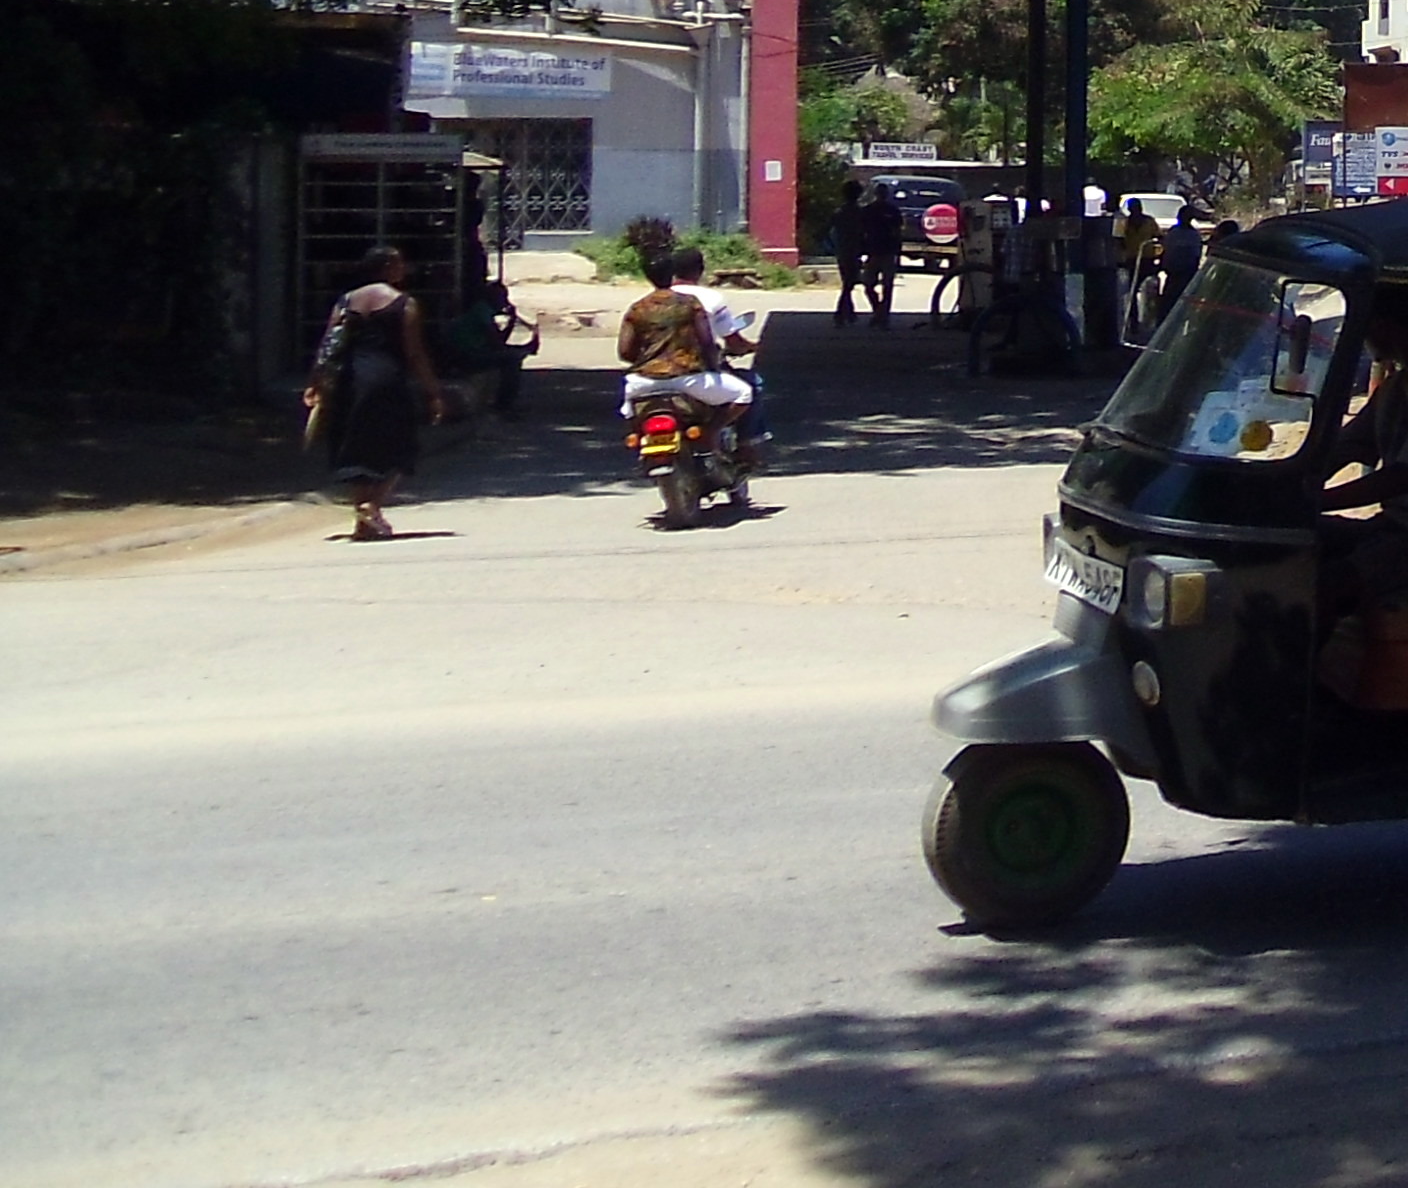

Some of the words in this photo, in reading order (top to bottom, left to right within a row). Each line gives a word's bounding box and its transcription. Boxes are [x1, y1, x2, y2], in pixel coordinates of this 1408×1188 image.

[592, 58, 606, 70] of
[454, 70, 533, 84] Professional
[537, 73, 585, 86] Studies
